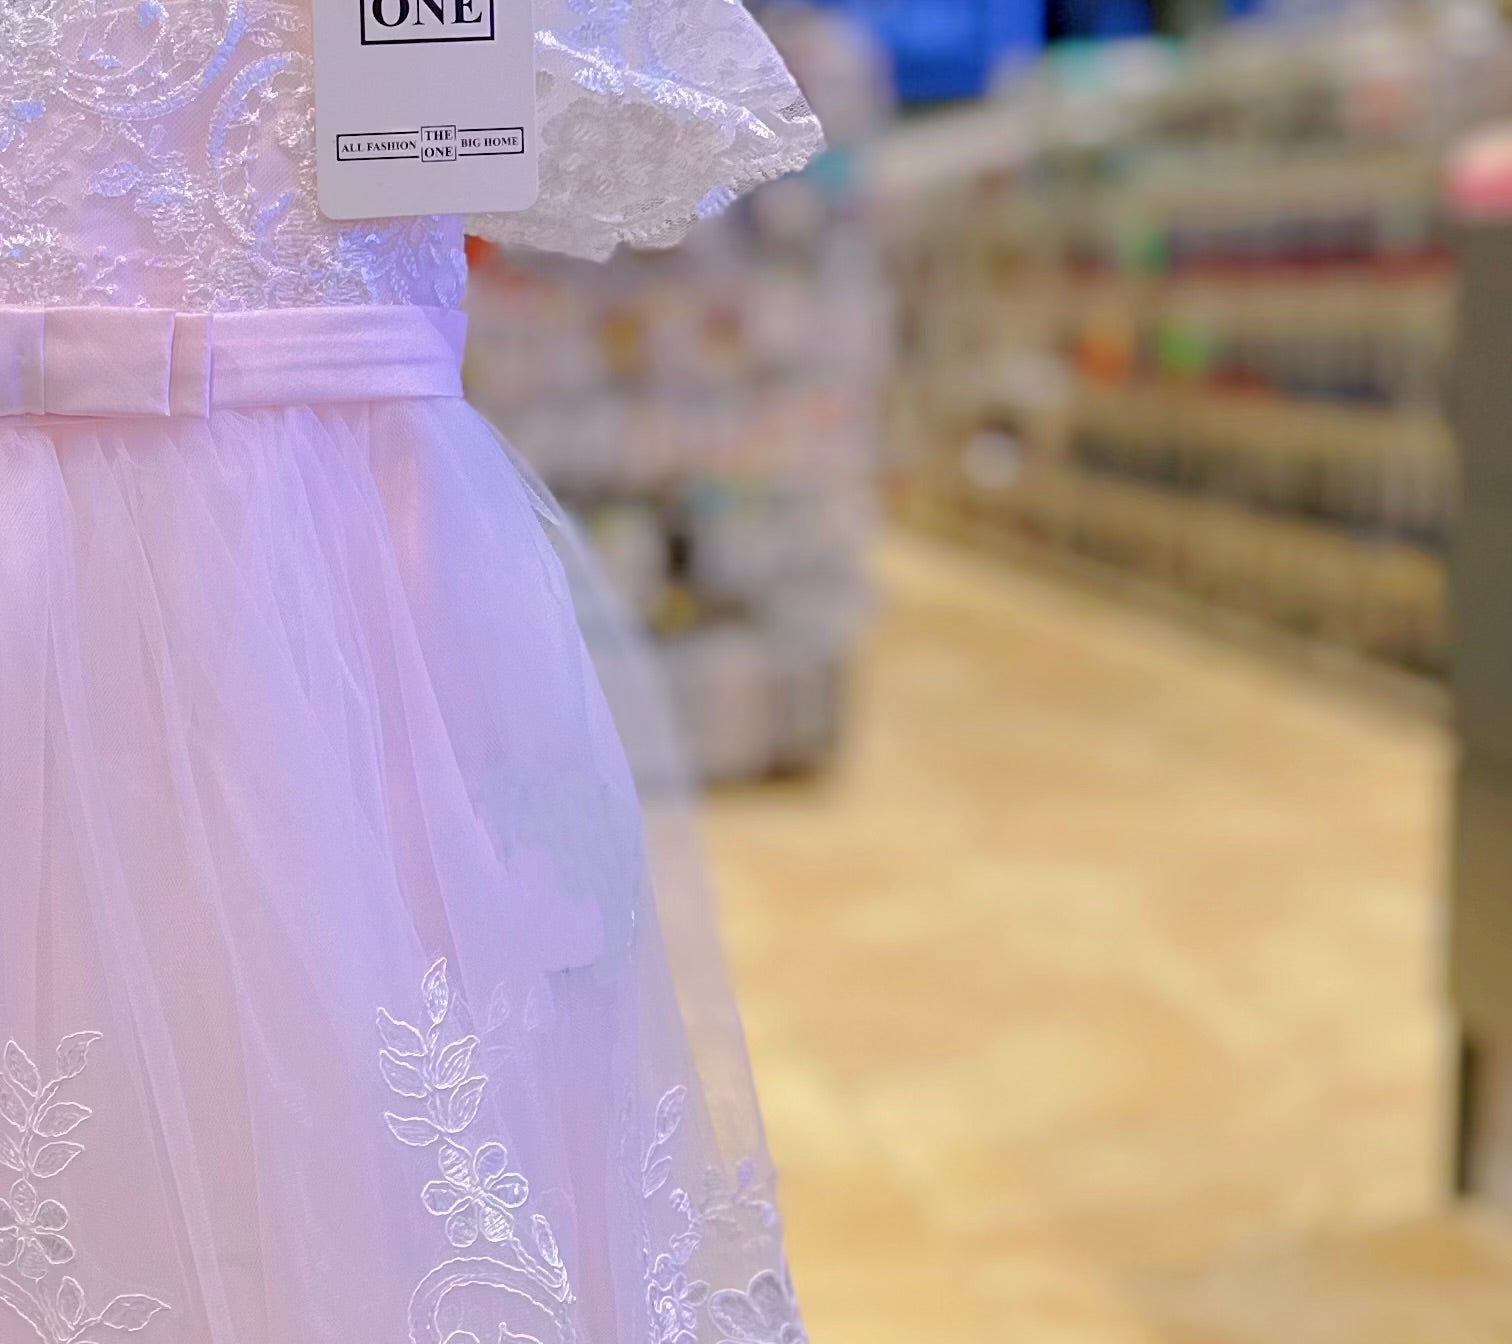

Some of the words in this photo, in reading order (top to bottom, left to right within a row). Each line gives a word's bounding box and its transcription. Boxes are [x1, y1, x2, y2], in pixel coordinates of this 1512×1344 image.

[423, 129, 453, 142] THE
[341, 143, 364, 154] ALL
[367, 140, 417, 153] FASHION
[460, 137, 481, 148] BIG
[484, 136, 519, 147] HOME
[424, 146, 454, 158] ONE
